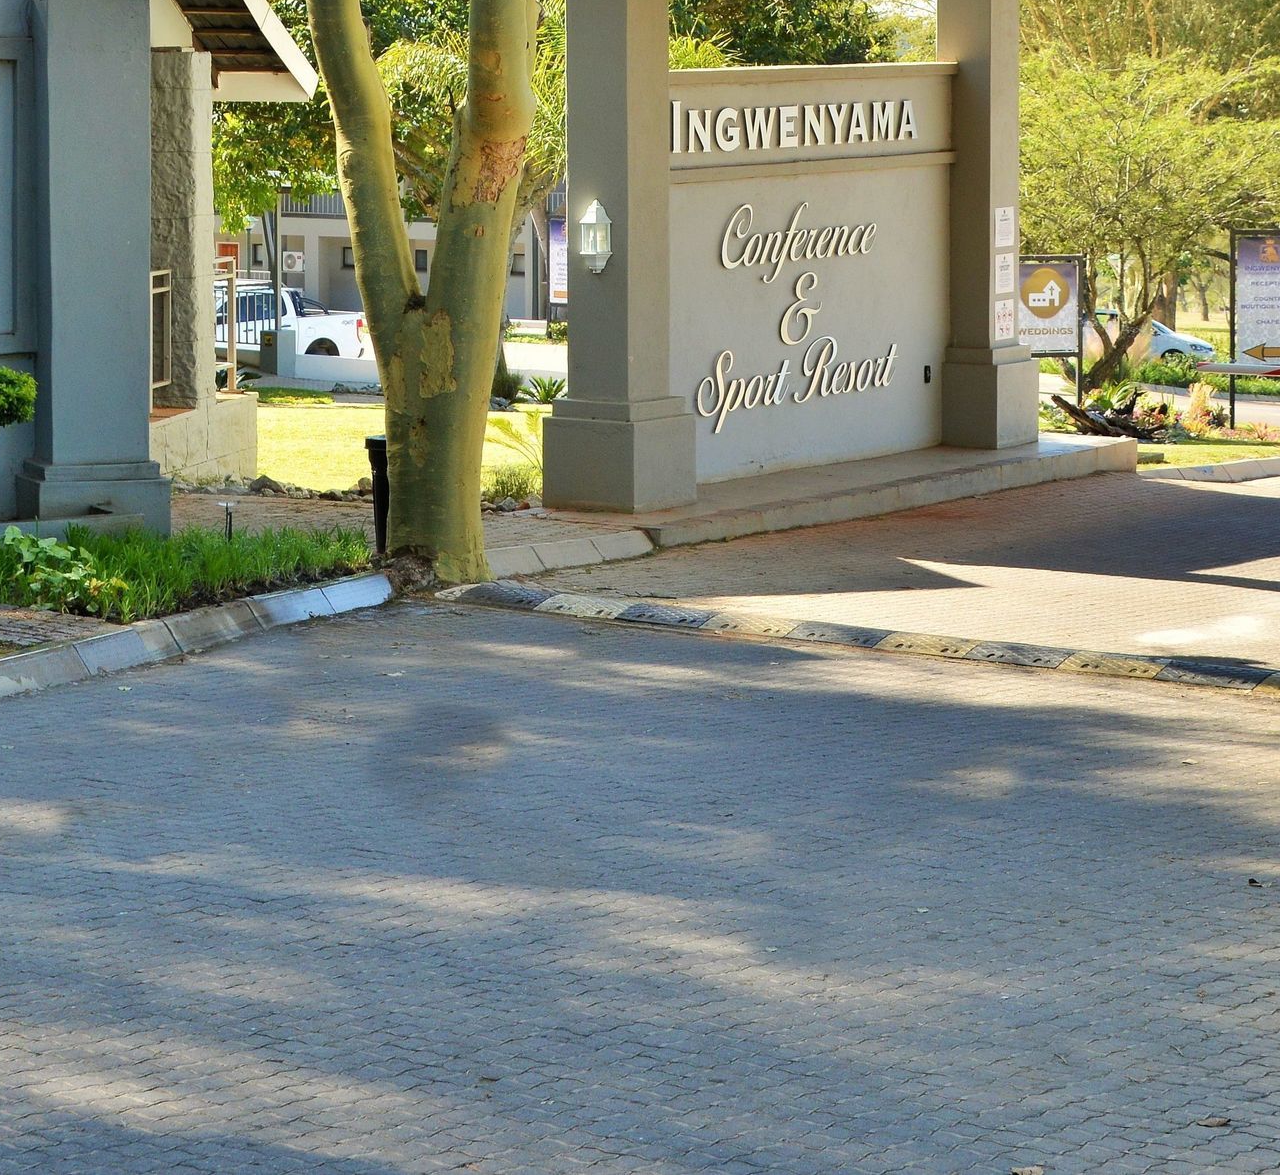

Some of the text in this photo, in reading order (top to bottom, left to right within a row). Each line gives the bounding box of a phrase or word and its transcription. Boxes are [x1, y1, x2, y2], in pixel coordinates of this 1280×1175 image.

[670, 99, 918, 154] INGWENYAMA
[721, 201, 877, 284] Conference
[780, 272, 822, 346] &
[1019, 327, 1074, 335] WEDDINGS
[697, 335, 898, 434] Sport Resort
